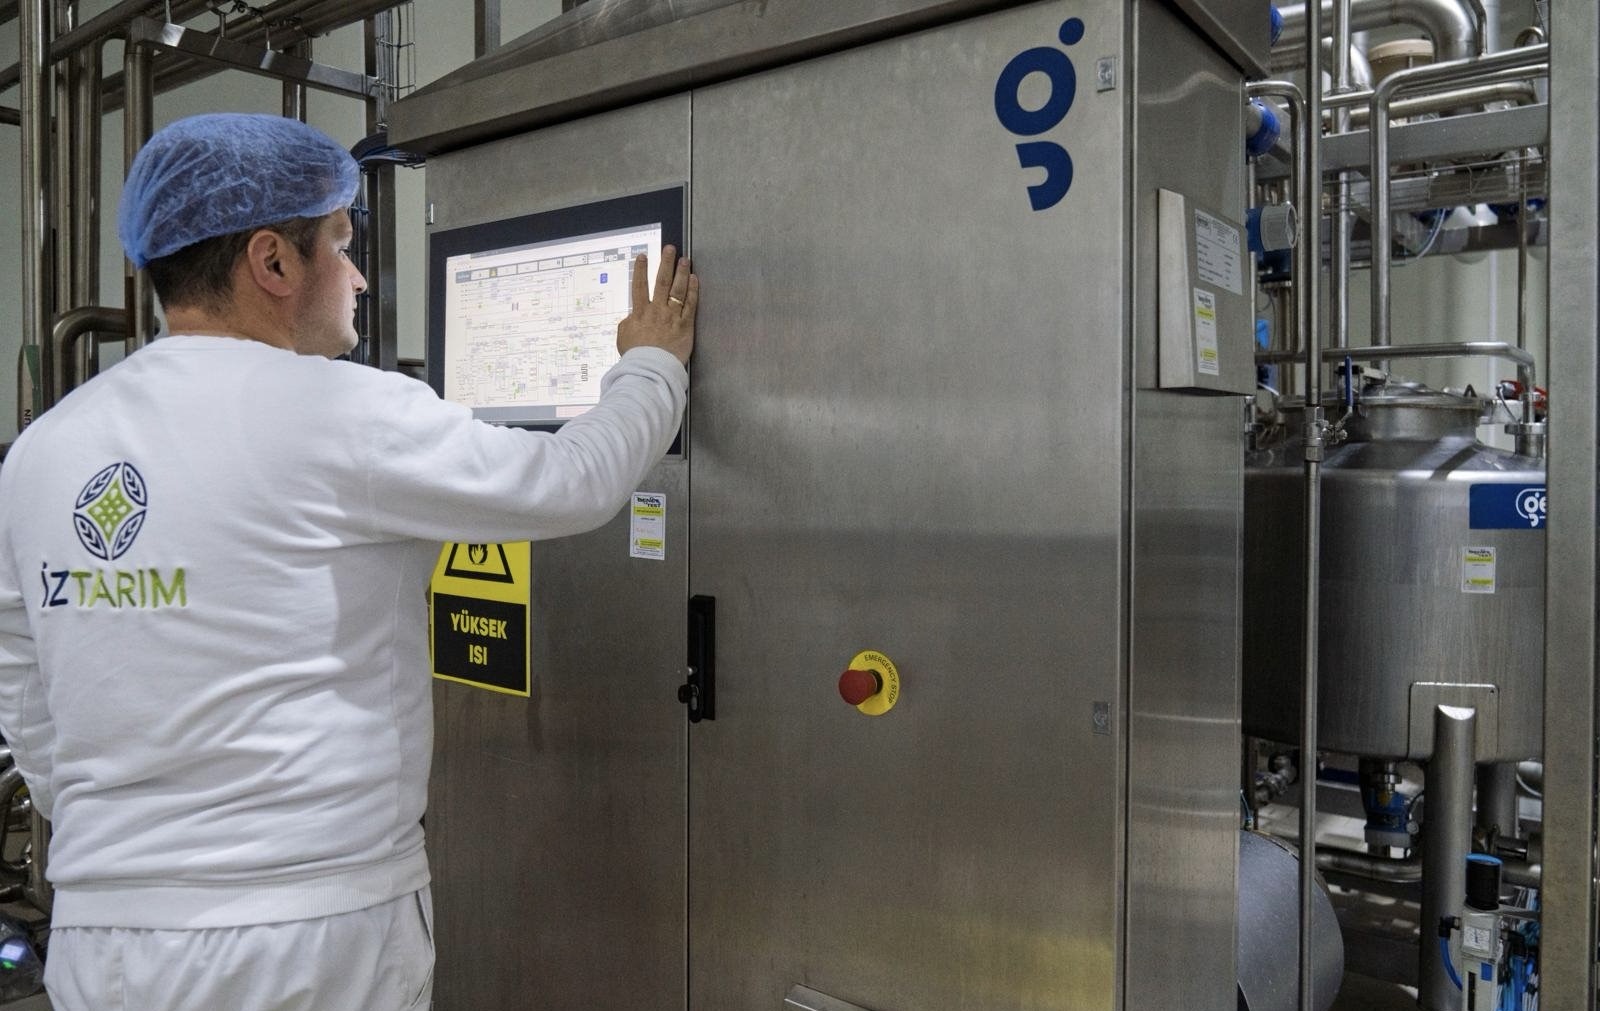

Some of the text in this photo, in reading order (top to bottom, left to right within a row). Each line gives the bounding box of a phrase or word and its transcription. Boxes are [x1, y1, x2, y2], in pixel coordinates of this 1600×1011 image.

[450, 609, 508, 640] YÜKSEK
[469, 644, 488, 665] ISI
[864, 654, 897, 704] EMERGENCY STOP
